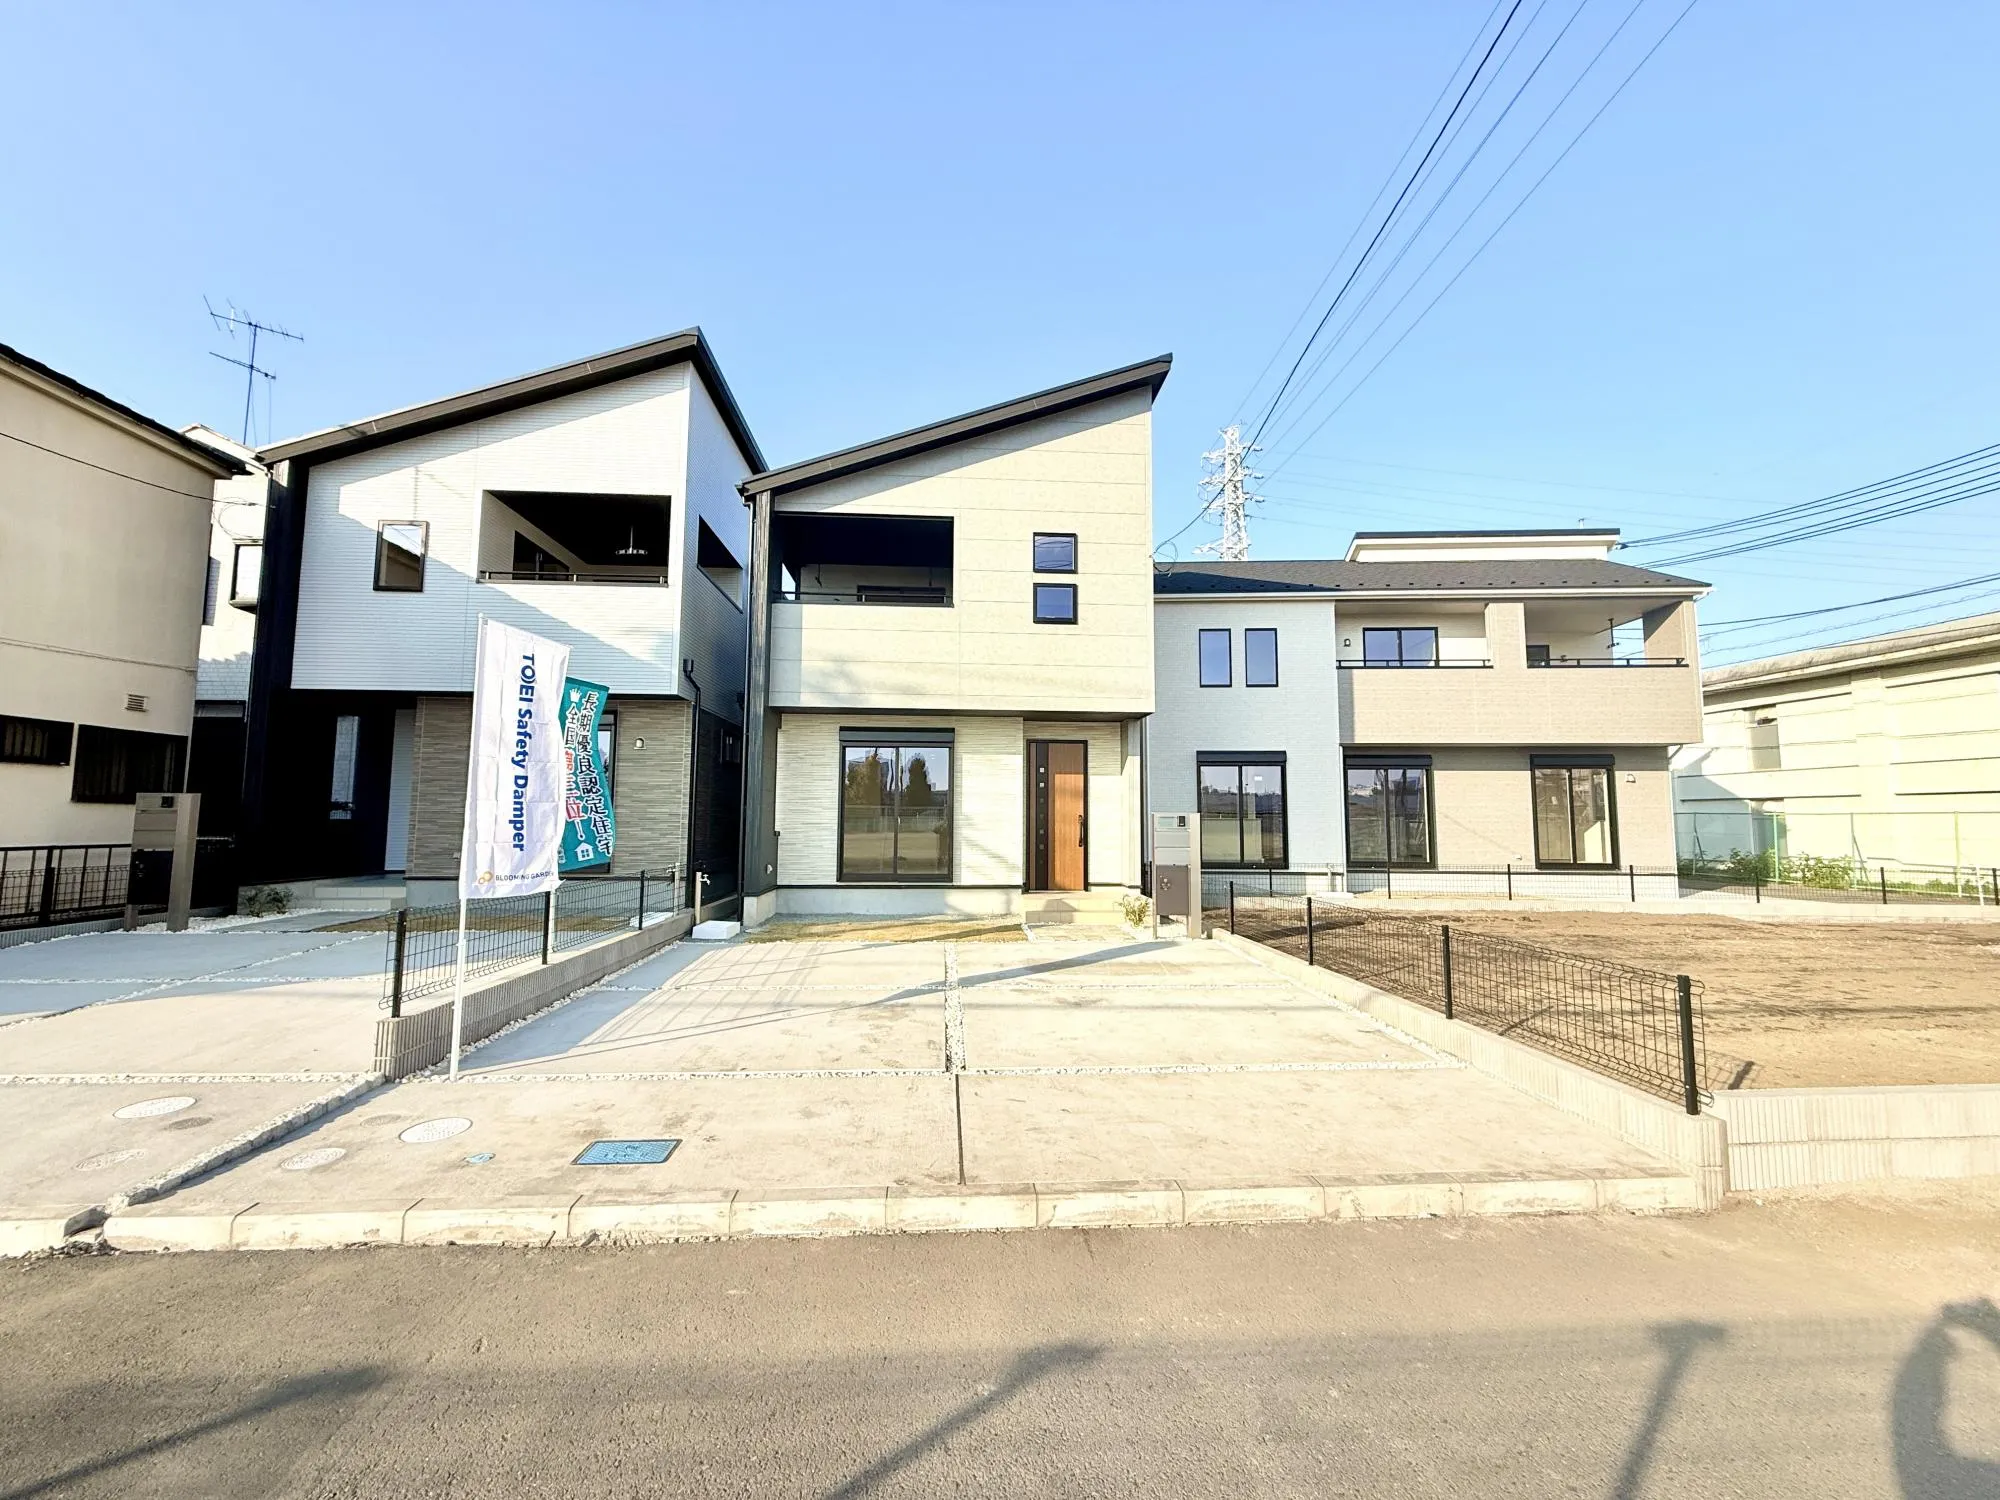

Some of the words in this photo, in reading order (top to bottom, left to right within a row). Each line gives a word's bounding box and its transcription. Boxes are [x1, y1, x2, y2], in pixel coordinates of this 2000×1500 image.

[519, 653, 536, 703] TOEI
[511, 708, 533, 769] Safety
[577, 691, 612, 856] 長期優良認定住宅
[508, 775, 529, 852] Damper
